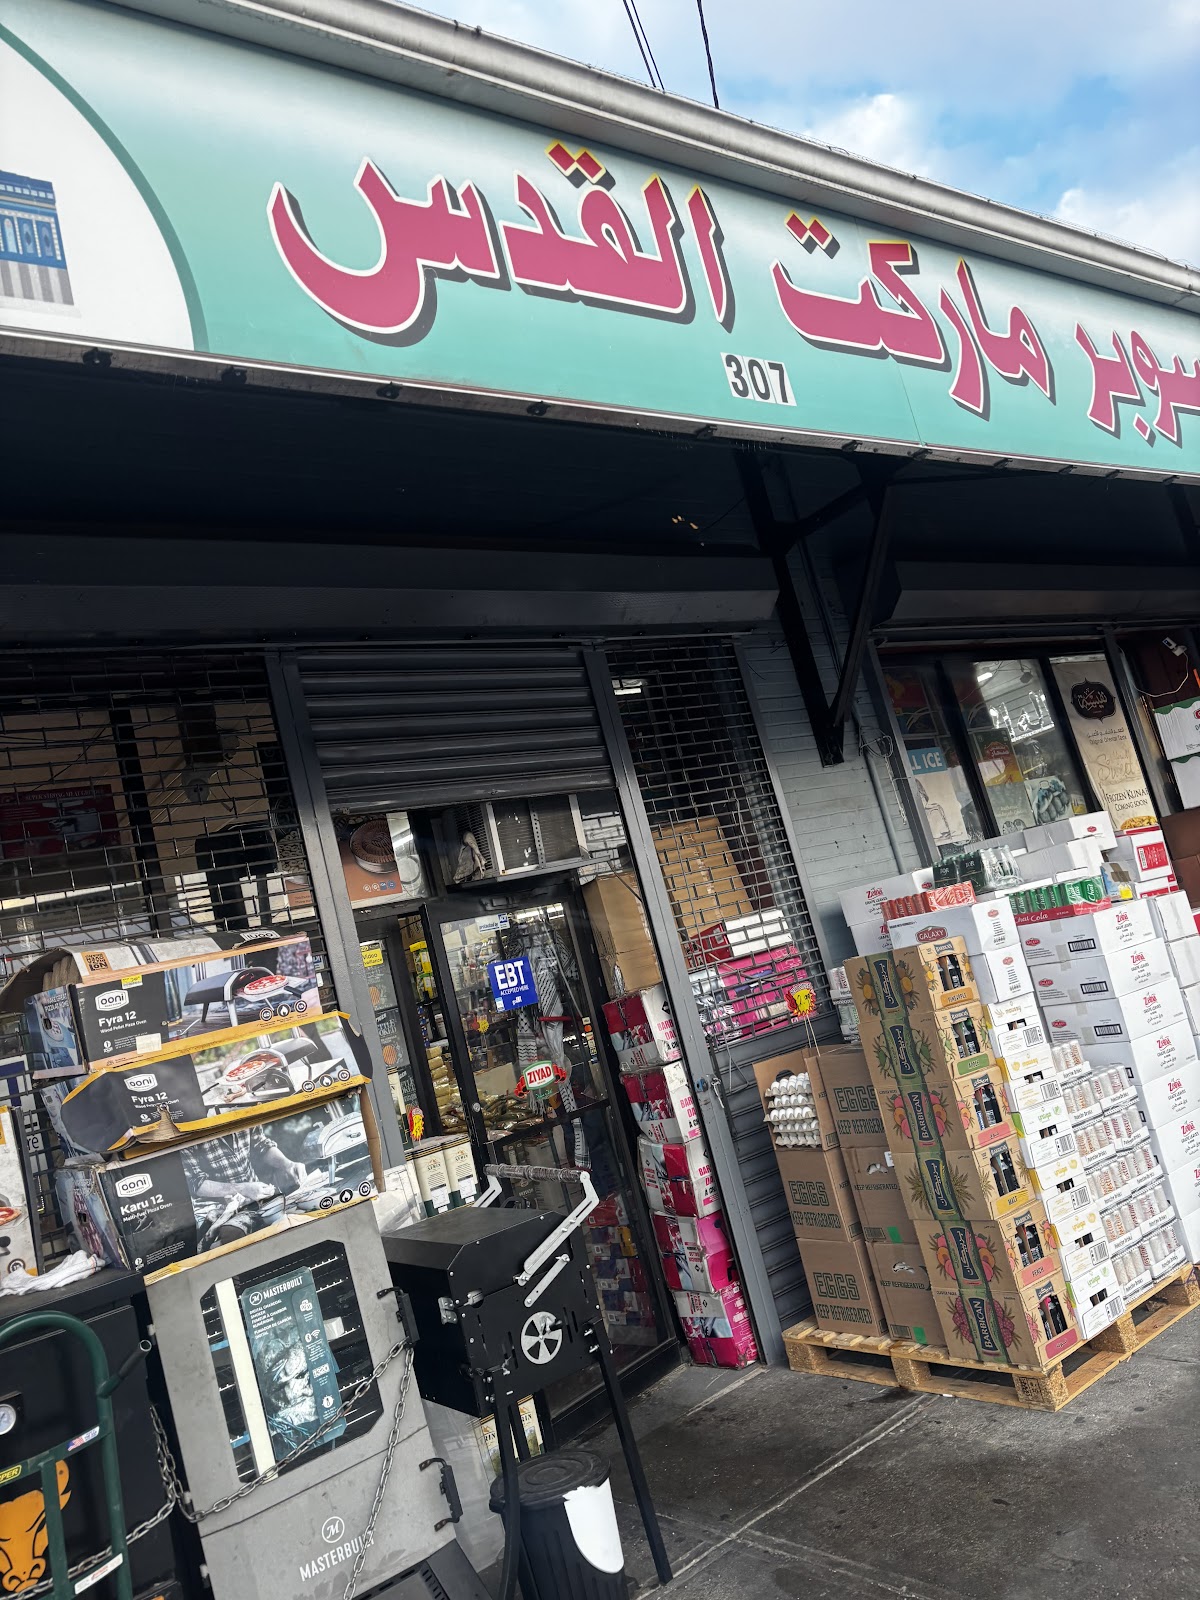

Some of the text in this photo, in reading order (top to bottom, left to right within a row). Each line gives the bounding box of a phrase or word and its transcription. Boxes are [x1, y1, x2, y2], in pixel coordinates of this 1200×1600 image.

[267, 140, 732, 340] القدس
[724, 353, 790, 405] 307
[924, 751, 943, 768] ICE
[1105, 792, 1127, 802] FROZEN
[1114, 799, 1148, 811] COMING SOON
[1031, 912, 1049, 922] Cola
[919, 929, 944, 940] GALAXY
[494, 960, 525, 990] EBT
[101, 994, 124, 1005] ooni
[500, 988, 520, 996] ACCEPTED
[98, 1011, 137, 1027] Fyra 12
[130, 1077, 152, 1086] ooni
[527, 1066, 552, 1084] ZIYAD
[131, 1092, 168, 1104] Fyra 12
[833, 1085, 880, 1113] EGGS
[912, 1094, 930, 1138] BARBICAN
[121, 1177, 147, 1192] ooni
[788, 1180, 829, 1206] EGGS
[120, 1194, 164, 1216] Karu 12
[122, 1209, 147, 1223] Multi-Fuel
[160, 1202, 172, 1211] Oven
[791, 1211, 804, 1226] KEEP
[263, 1276, 303, 1296] MASTERBUILT
[813, 1271, 860, 1300] EGGS
[263, 1299, 282, 1309] CHARCOAL
[250, 1311, 266, 1319] SMOKER
[815, 1303, 873, 1324] KEEP REFRIGERATED
[973, 1300, 993, 1349] BARBICAN
